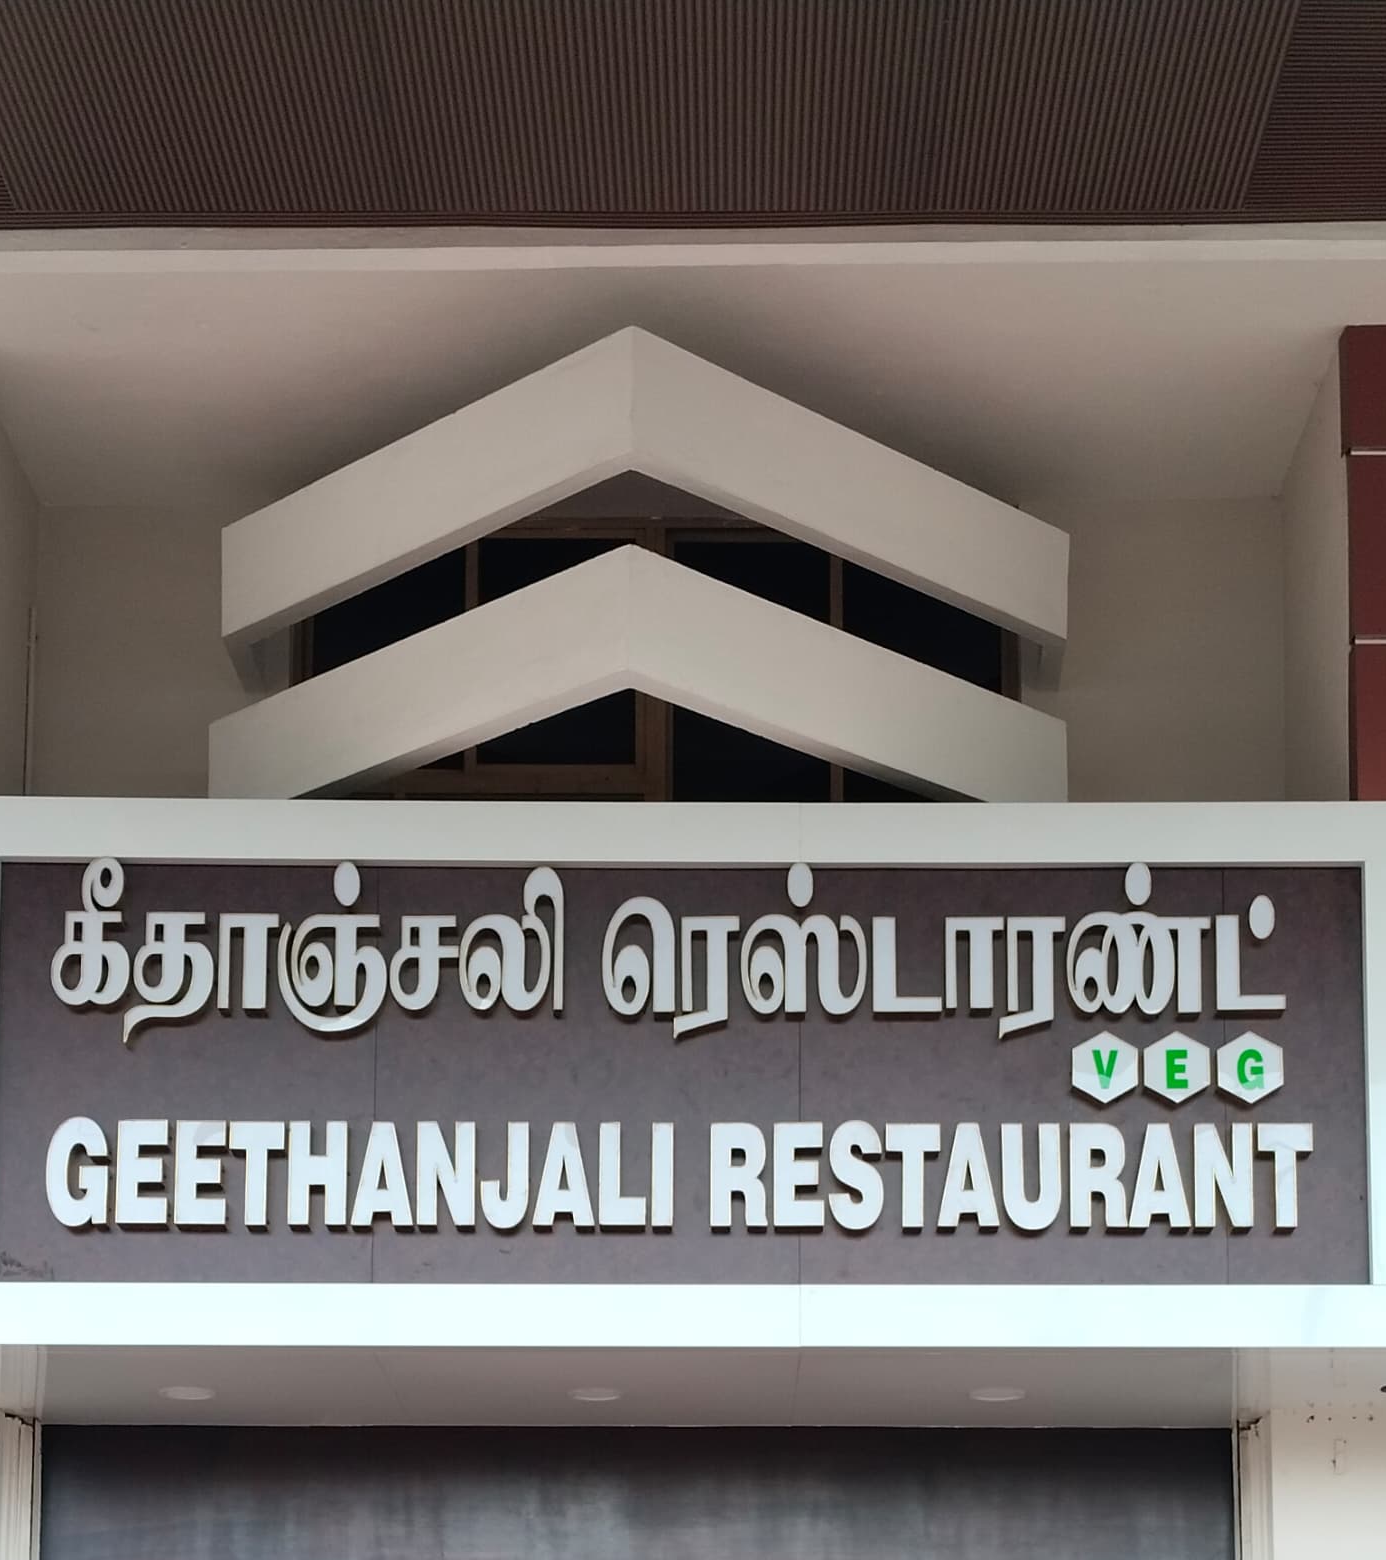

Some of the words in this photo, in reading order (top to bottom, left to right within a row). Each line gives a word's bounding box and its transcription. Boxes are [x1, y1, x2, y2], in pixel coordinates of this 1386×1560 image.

[50, 856, 565, 1045] கீதாஞ்சலி
[601, 861, 1287, 1039] ரெஸ்டாரண்ட்
[1091, 1048, 1266, 1091] VEG
[45, 1115, 676, 1231] GEETHANJALI
[709, 1119, 1316, 1235] RESTAURANT
